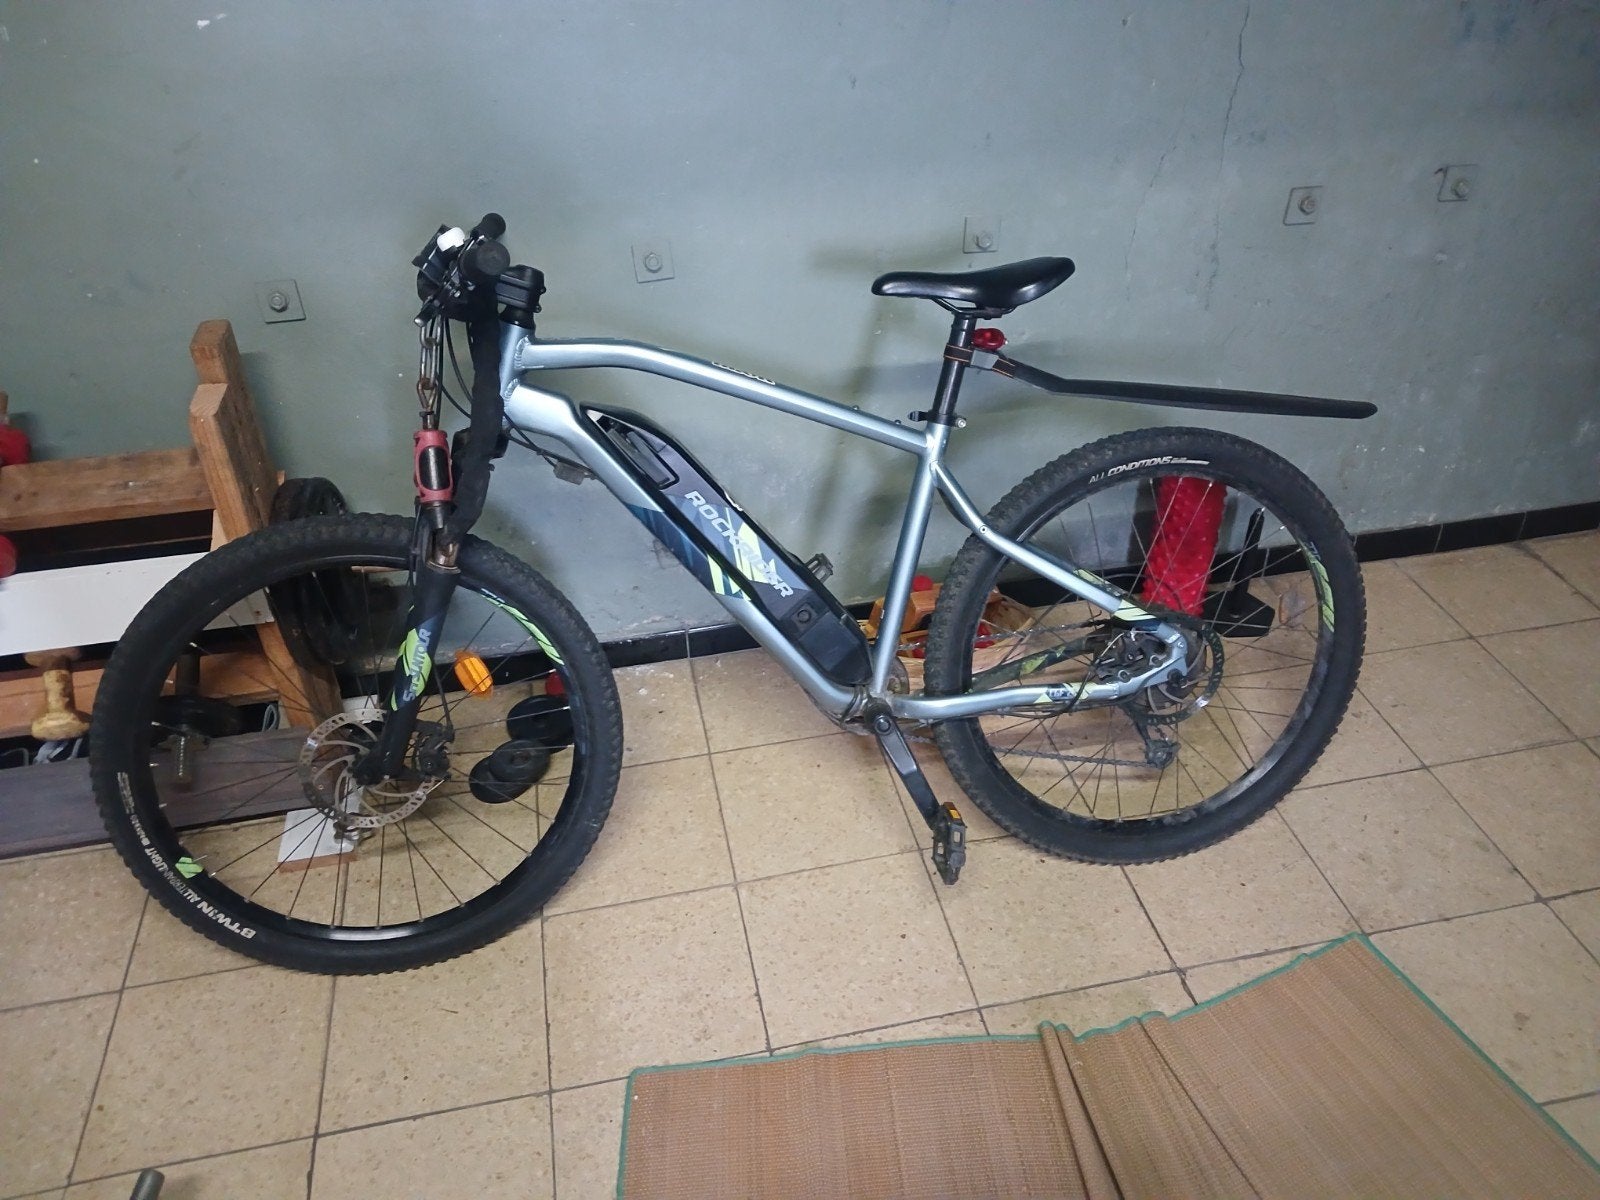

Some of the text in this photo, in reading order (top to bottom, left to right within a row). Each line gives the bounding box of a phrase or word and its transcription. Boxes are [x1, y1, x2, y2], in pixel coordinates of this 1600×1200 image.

[1088, 472, 1105, 485] ALL
[1107, 455, 1173, 477] CONDITIONS
[684, 491, 794, 598] ROCKRIDER
